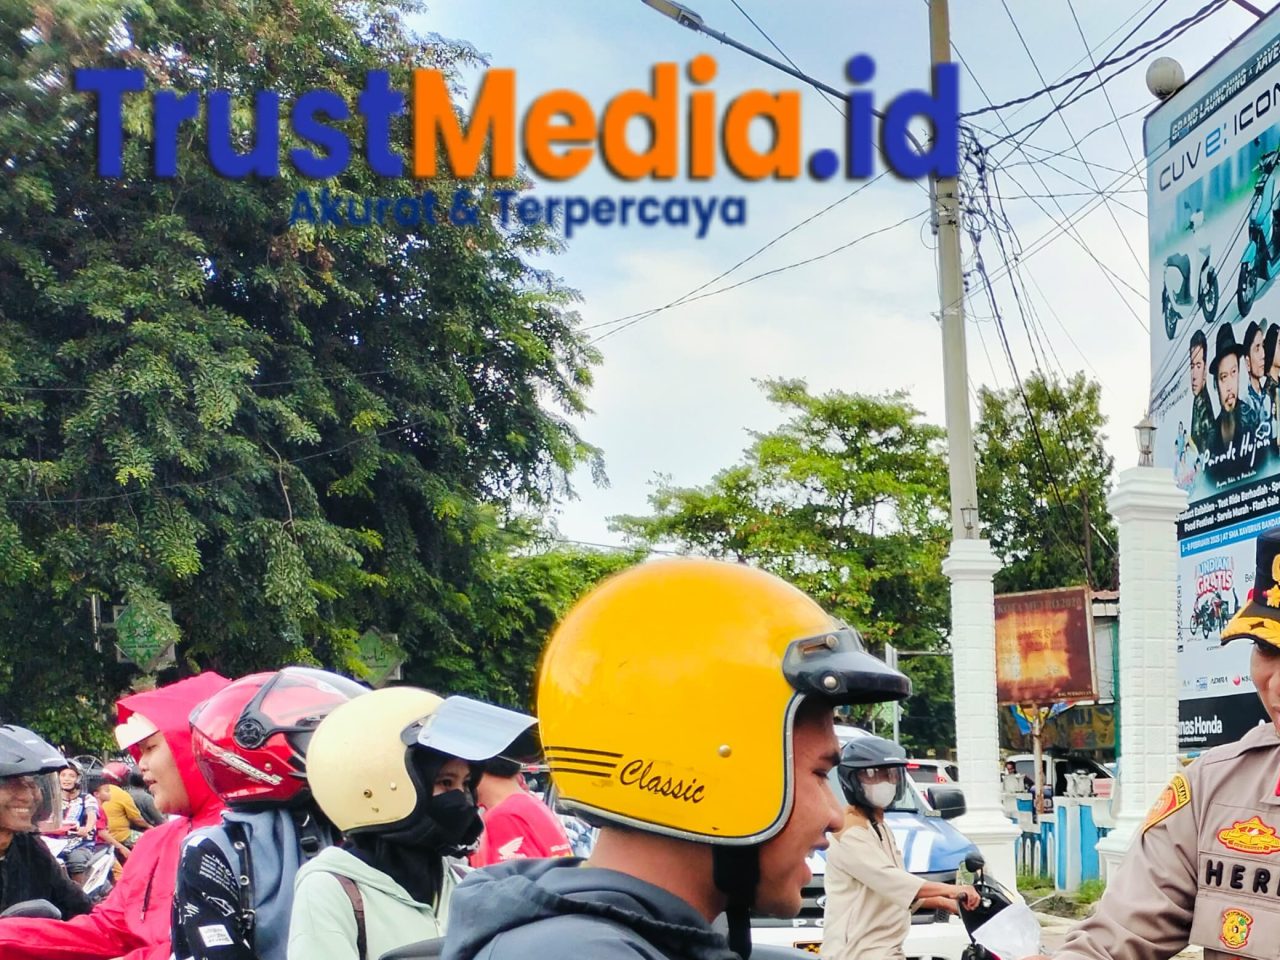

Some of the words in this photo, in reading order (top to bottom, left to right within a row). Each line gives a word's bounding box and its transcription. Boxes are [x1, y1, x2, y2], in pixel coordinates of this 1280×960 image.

[1200, 68, 1248, 115] LAUNCHING
[1159, 141, 1202, 192] CUV
[620, 758, 706, 805] Classic
